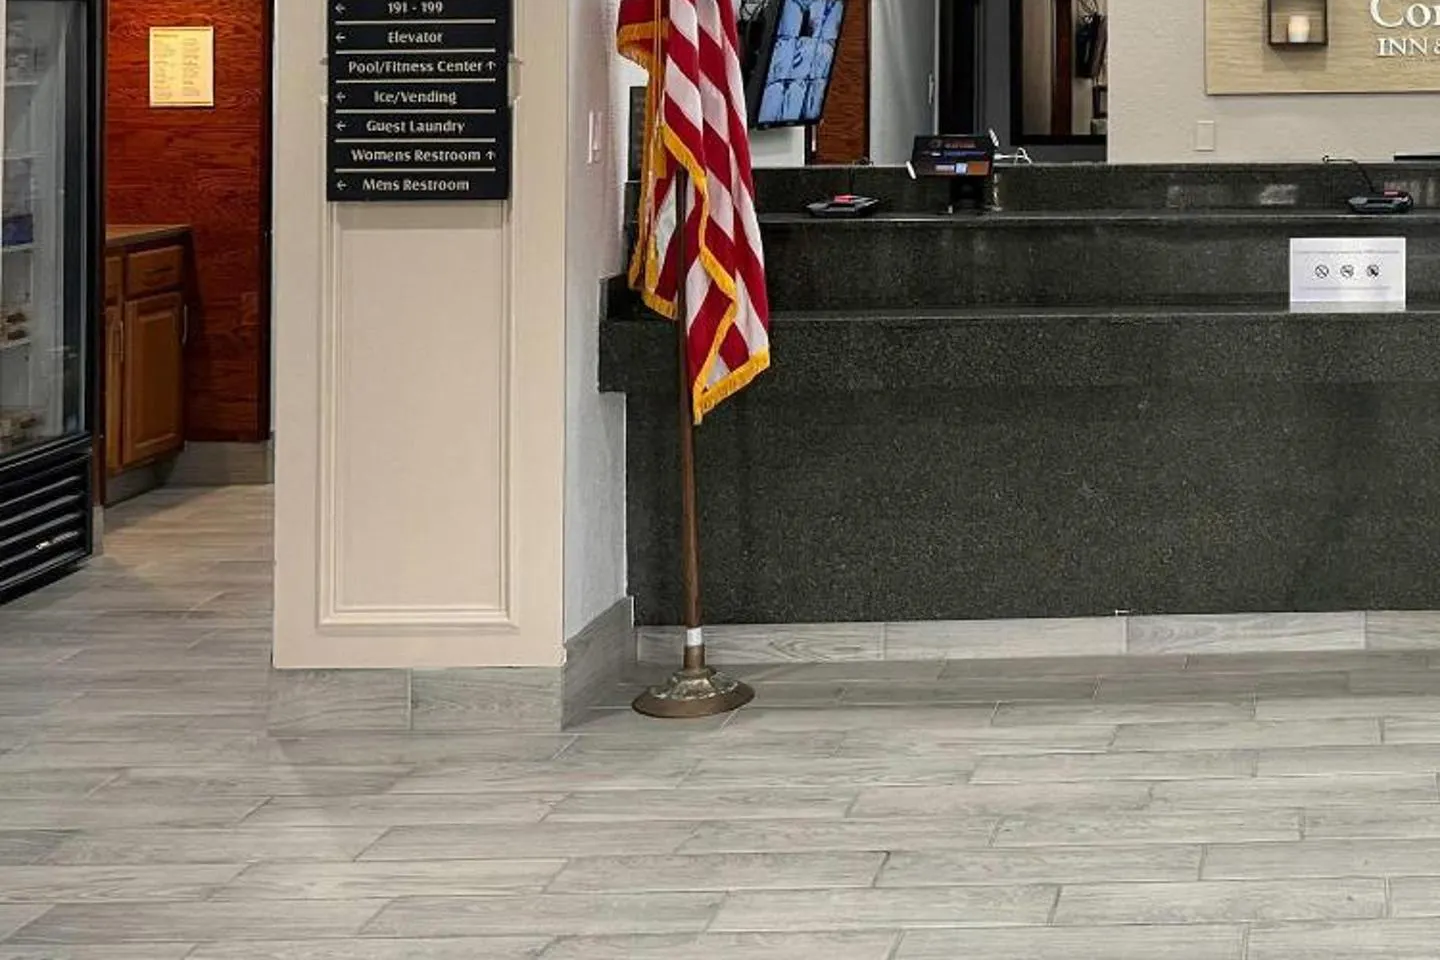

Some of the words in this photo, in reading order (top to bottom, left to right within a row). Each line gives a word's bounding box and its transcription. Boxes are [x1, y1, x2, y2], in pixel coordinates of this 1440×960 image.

[387, 1, 408, 14] 191
[421, 1, 443, 14] 199
[388, 30, 443, 44] Elevator
[1377, 36, 1429, 57] INN
[349, 60, 434, 74] Pool/Fitness
[437, 60, 483, 73] Center
[374, 90, 457, 106] Ice/Vending
[366, 120, 406, 133] Guest
[409, 120, 465, 135] Laundry
[351, 149, 411, 162] Womens
[414, 149, 481, 162] Restroom
[362, 178, 400, 192] Mens
[403, 179, 470, 192] Restroom
